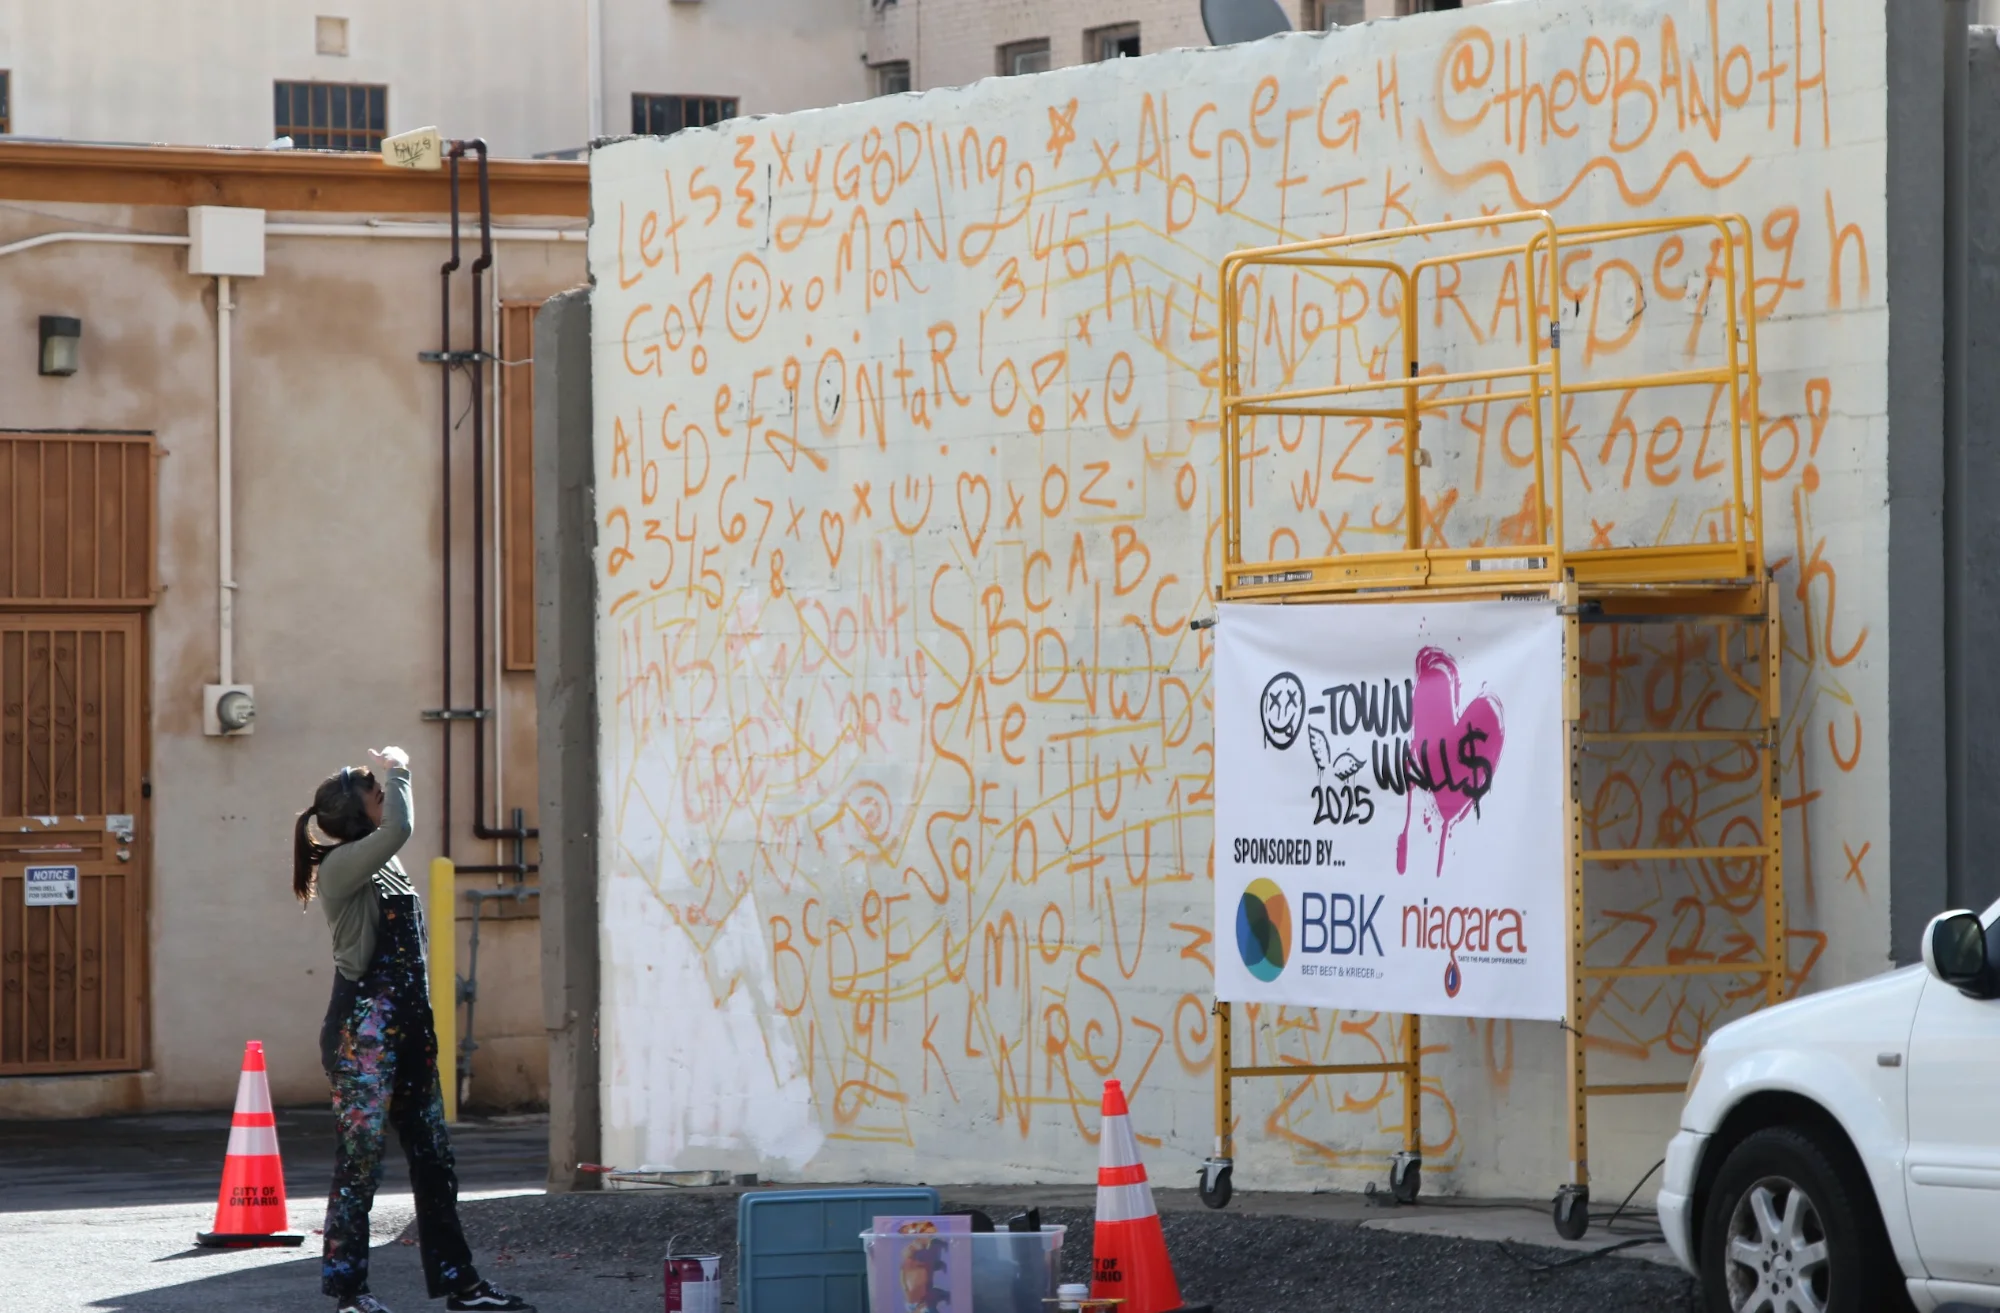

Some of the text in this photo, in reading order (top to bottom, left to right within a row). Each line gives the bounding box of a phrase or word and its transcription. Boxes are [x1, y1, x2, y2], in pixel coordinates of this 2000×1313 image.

[1311, 785, 1375, 825] 2025
[1234, 837, 1346, 867] SPONSORED BY...
[33, 870, 69, 880] NOTICE
[1301, 892, 1386, 957] BBK
[1401, 897, 1528, 957] niagara
[1301, 965, 1318, 976] BEST
[1320, 966, 1337, 977] BEST
[1338, 967, 1345, 977] &
[1346, 967, 1375, 979] KRIEGER
[232, 1187, 275, 1196] CITY OF
[230, 1197, 279, 1206] ONTARIO
[1103, 1258, 1118, 1269] OF
